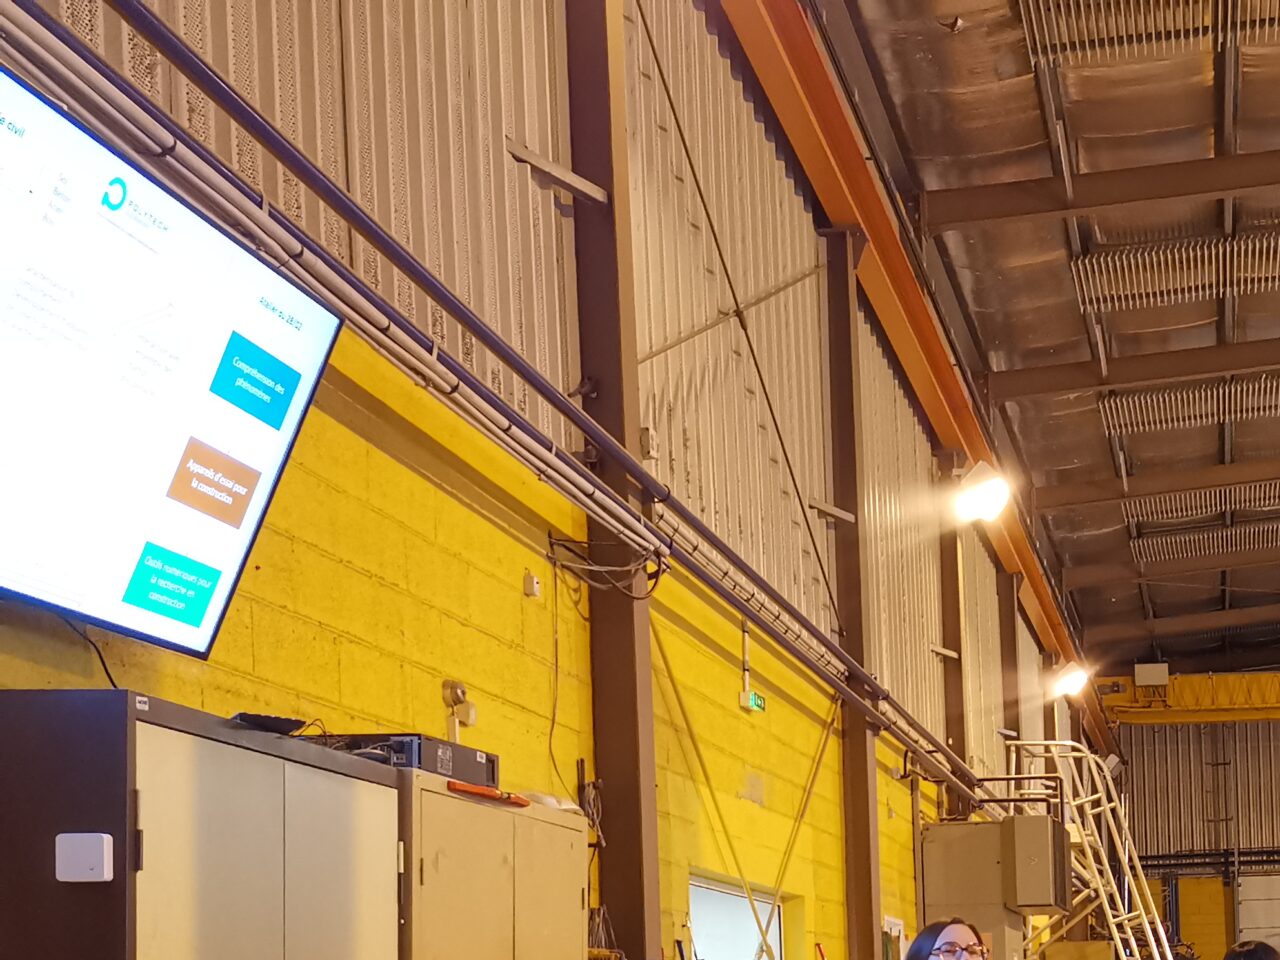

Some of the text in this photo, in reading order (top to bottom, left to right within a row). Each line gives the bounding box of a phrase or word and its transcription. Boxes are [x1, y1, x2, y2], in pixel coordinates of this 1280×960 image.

[7, 122, 26, 138] civil
[191, 477, 198, 488] la
[232, 484, 248, 495] pour
